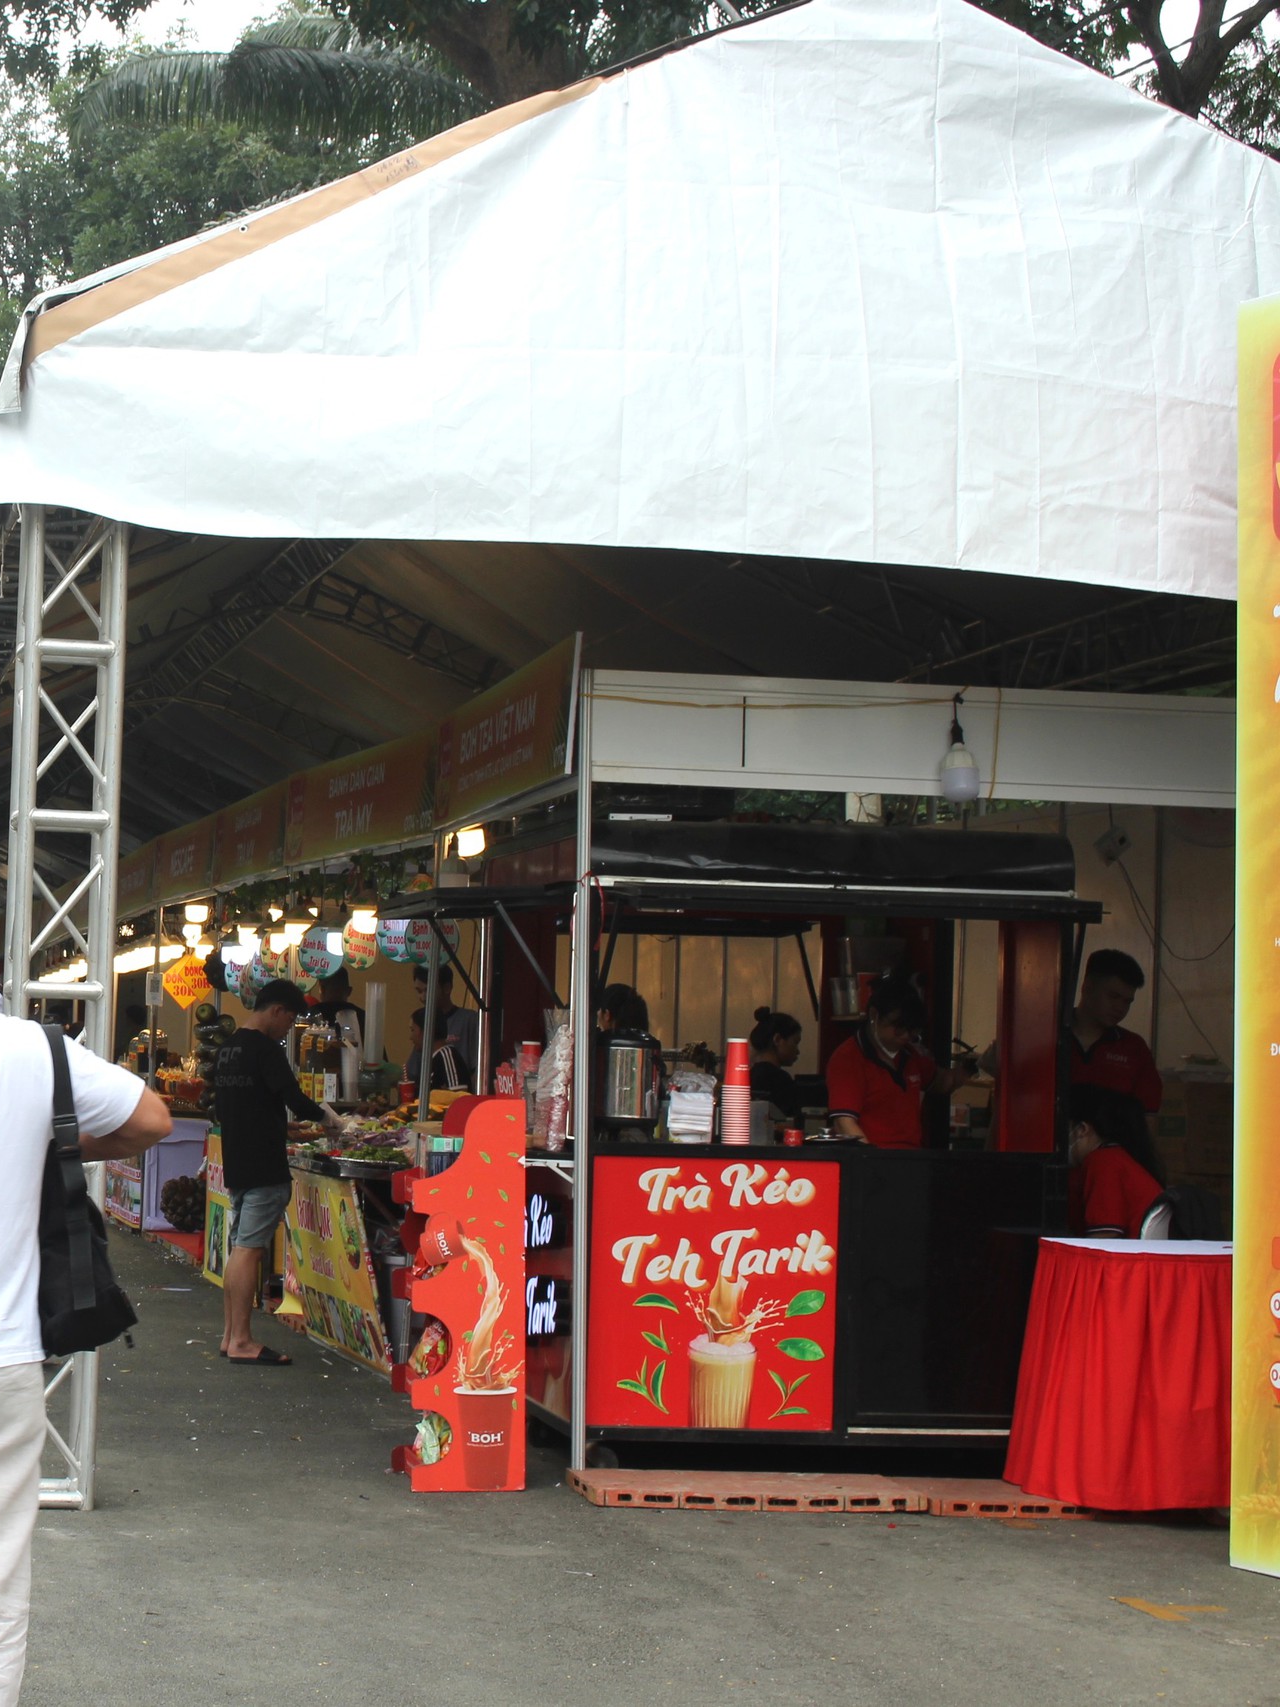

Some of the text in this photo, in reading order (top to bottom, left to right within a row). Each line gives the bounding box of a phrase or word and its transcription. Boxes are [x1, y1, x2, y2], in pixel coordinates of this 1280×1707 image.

[479, 716, 493, 755] TEA
[515, 692, 538, 736] NAM
[335, 800, 353, 840] TRÀ
[497, 1074, 514, 1095] BOH
[638, 1163, 816, 1215] Trà Kéo
[436, 1231, 451, 1256] BOH
[530, 1194, 553, 1248] Kéo
[611, 1227, 836, 1288] Teh Tarik
[526, 1275, 557, 1336] Tarik
[471, 1433, 501, 1443] BOH
